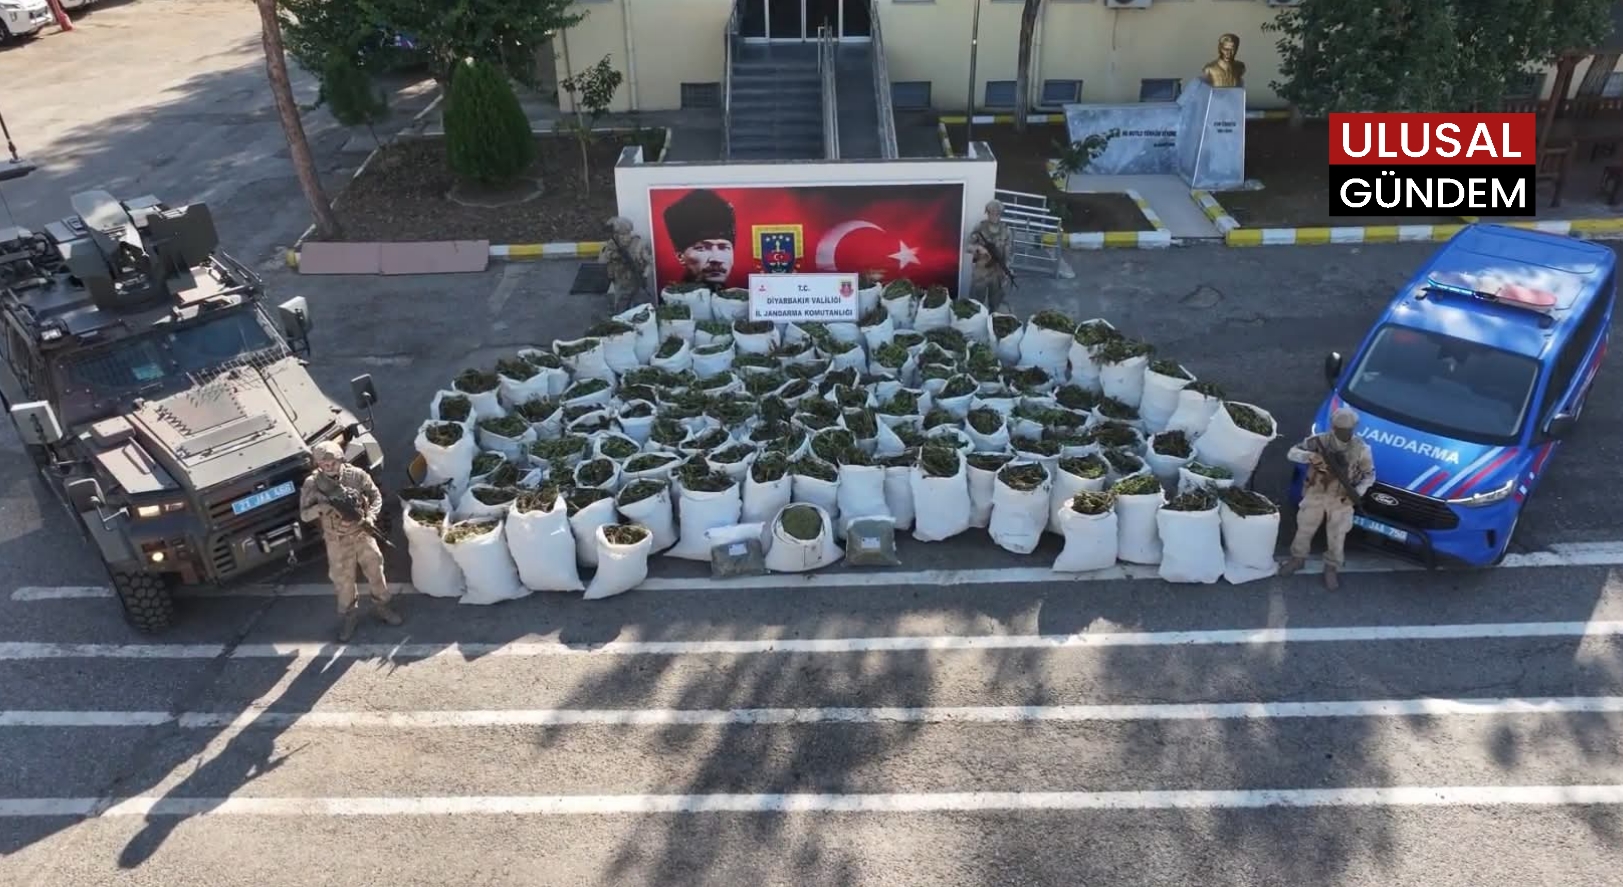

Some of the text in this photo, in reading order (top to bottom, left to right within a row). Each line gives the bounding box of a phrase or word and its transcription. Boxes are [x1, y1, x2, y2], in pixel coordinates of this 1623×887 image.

[767, 295, 841, 305] DİYARBAKIR VALİLİĞİ
[764, 309, 802, 317] JANDARMA
[804, 308, 853, 317] KOMUTANLIĞI
[1357, 426, 1460, 465] JANDARMA
